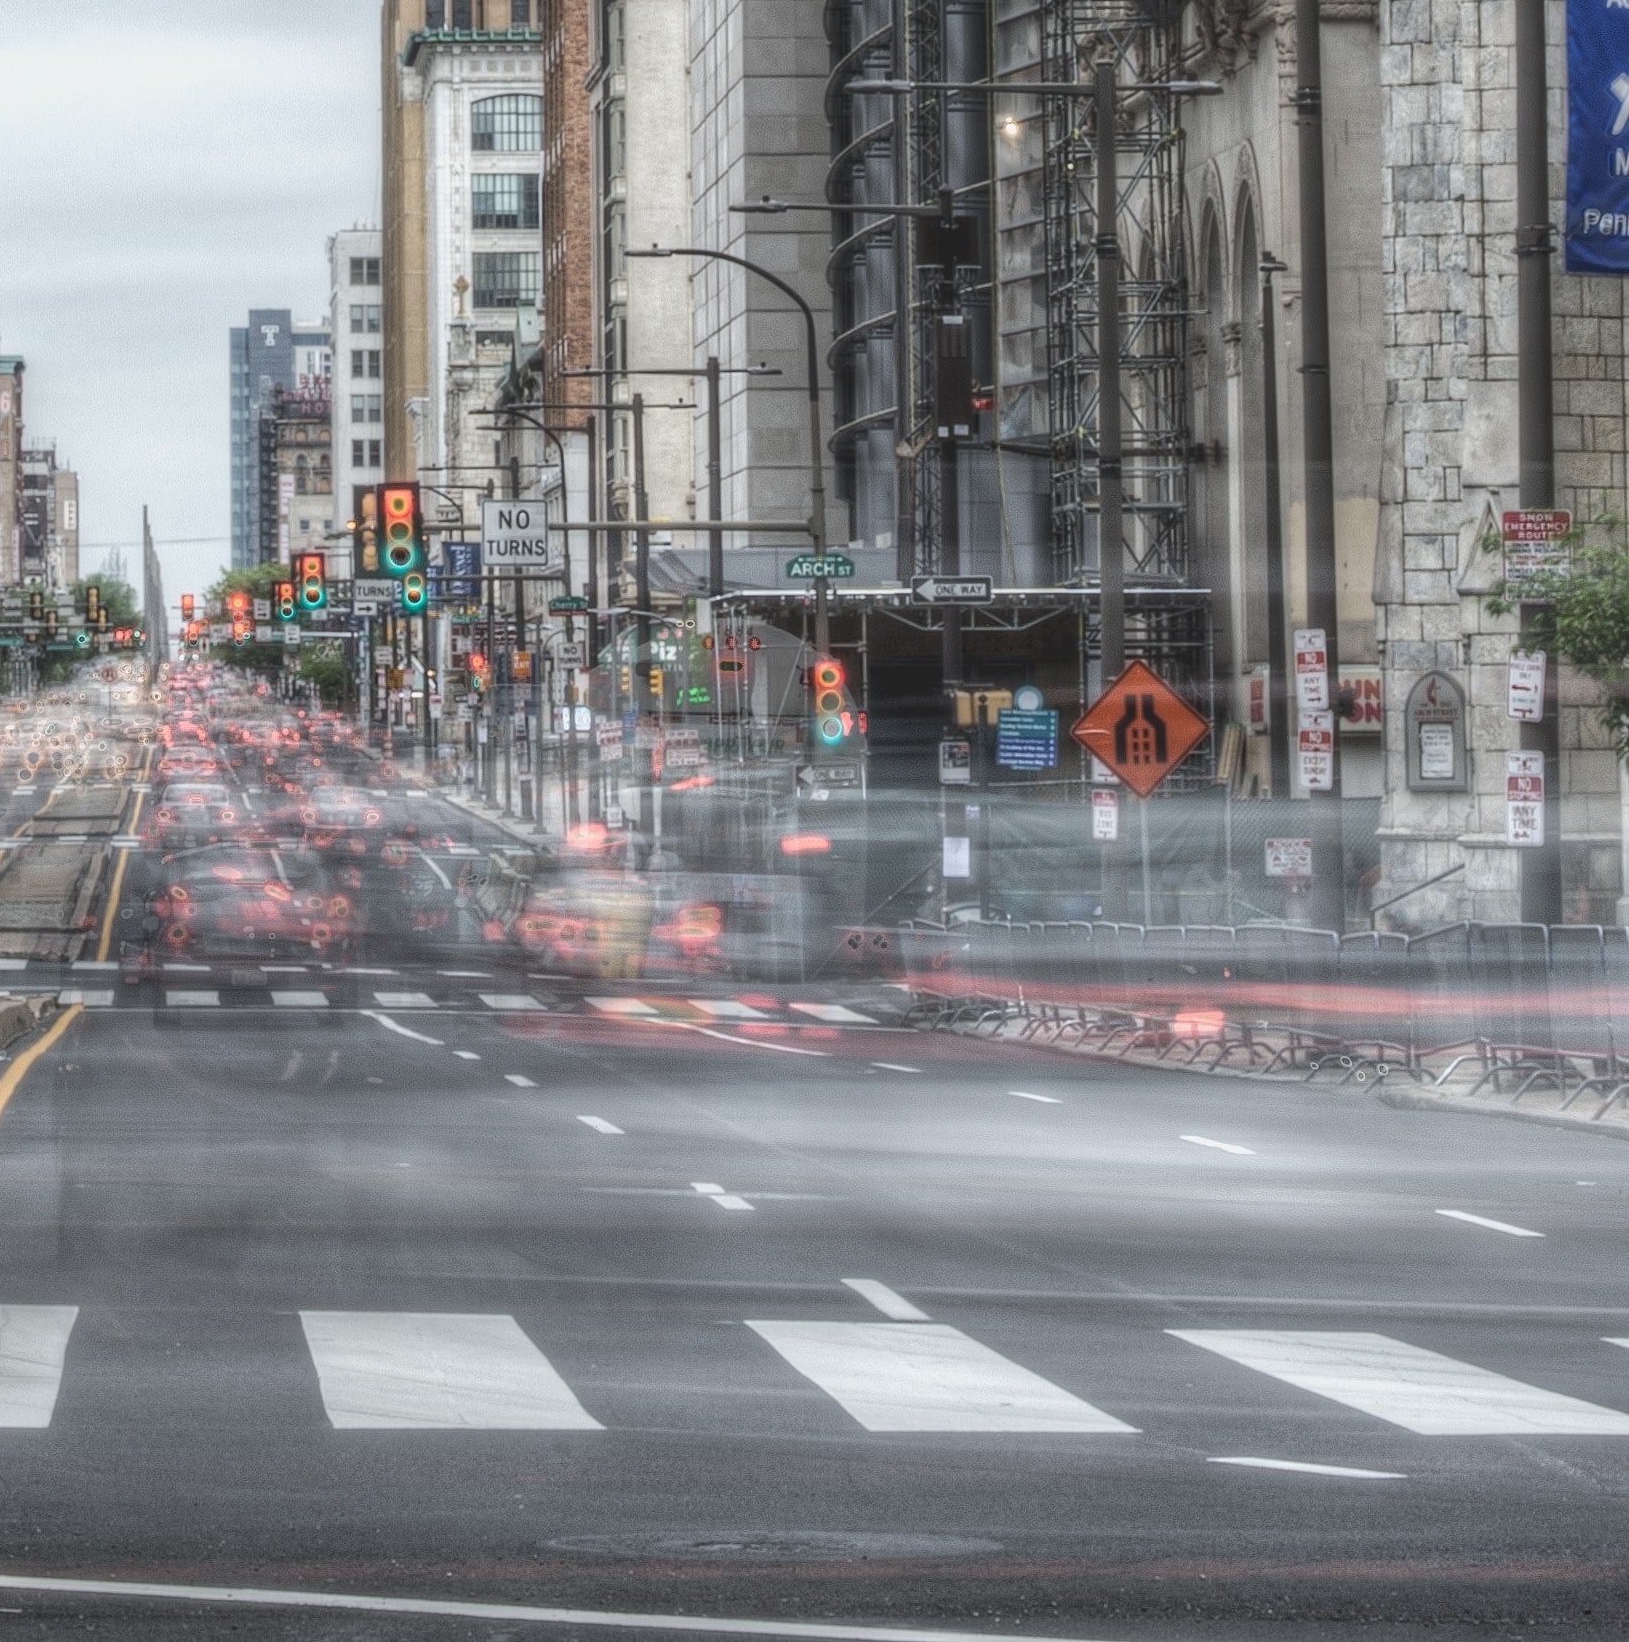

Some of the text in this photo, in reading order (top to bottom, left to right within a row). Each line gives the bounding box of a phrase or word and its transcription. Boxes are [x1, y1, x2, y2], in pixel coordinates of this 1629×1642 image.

[498, 510, 529, 529] NO
[487, 539, 545, 556] TURNS
[791, 562, 851, 576] ARCH ST
[356, 586, 392, 597] TURNS
[935, 586, 984, 596] ONE WAY
